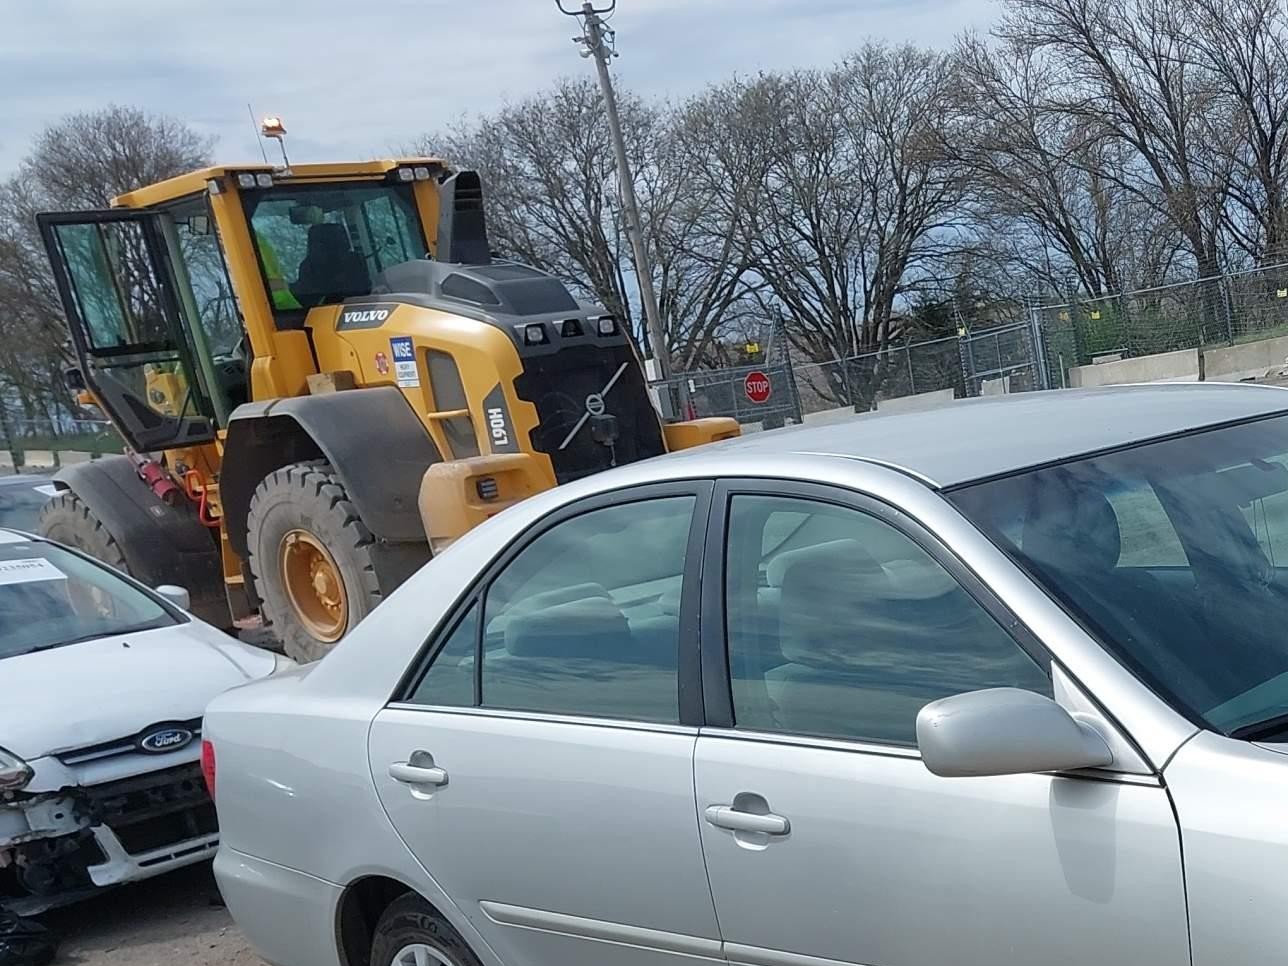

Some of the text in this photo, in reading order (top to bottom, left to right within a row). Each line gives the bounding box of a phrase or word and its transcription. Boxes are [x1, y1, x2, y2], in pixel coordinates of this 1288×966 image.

[344, 310, 388, 322] VOLVO
[392, 342, 412, 357] WISE
[746, 380, 769, 394] STOP
[488, 408, 508, 445] L90H
[154, 732, 182, 747] Ford
